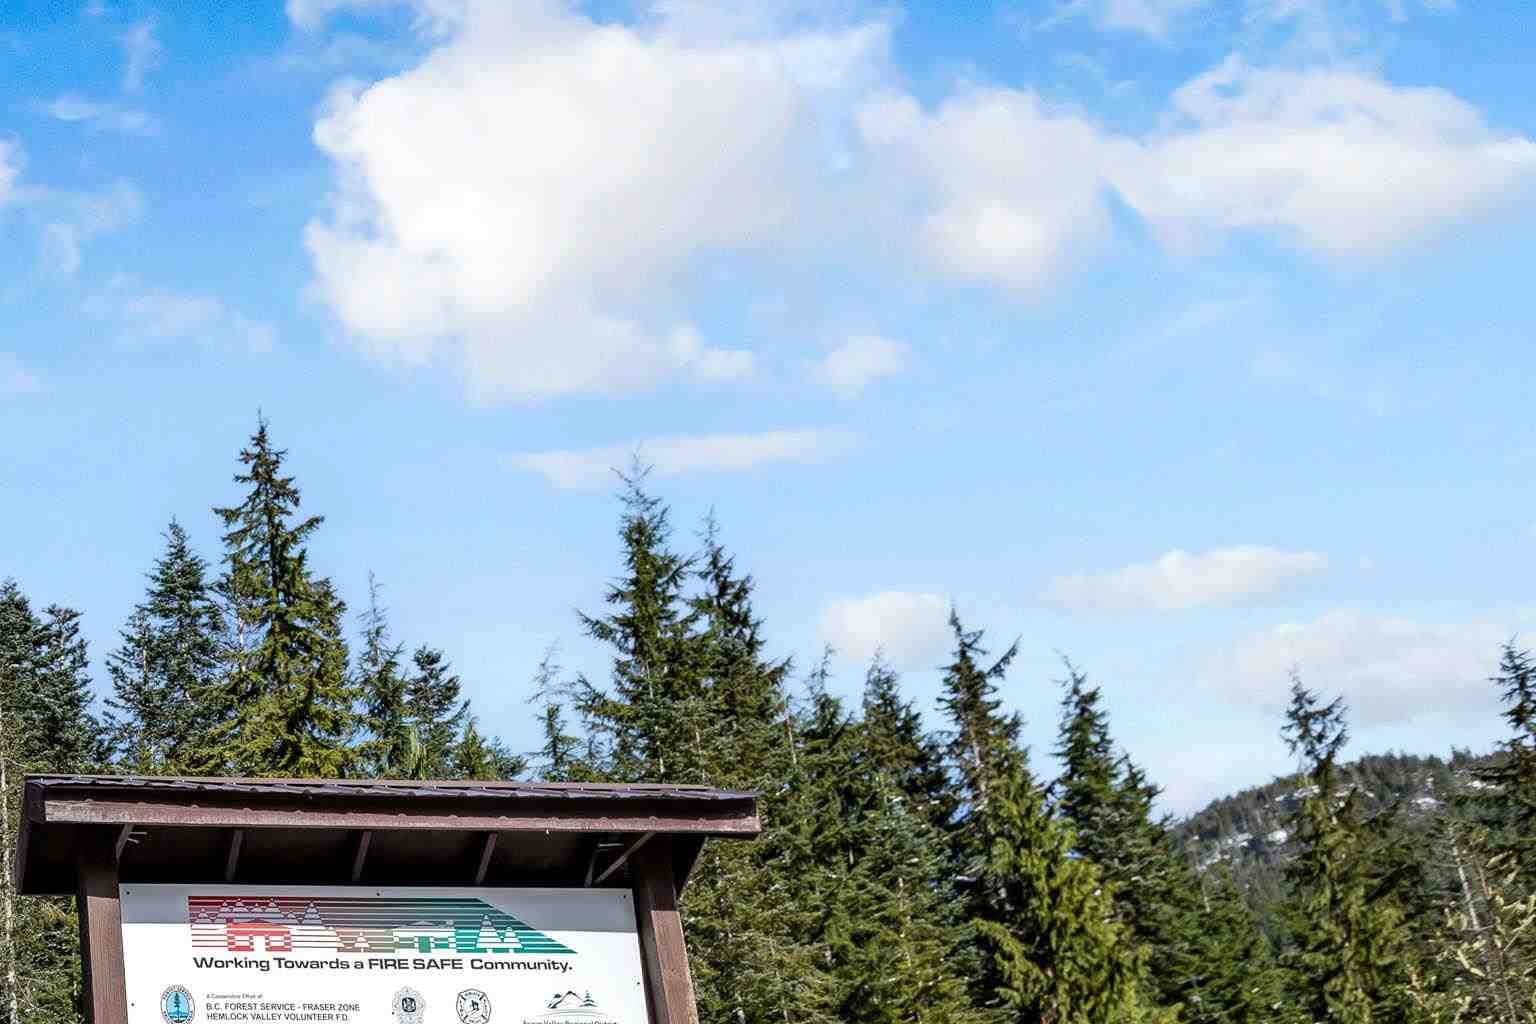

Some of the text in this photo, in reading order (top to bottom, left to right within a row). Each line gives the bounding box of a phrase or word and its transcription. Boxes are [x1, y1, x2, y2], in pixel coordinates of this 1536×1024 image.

[193, 957, 573, 973] Working Towards a FIRE SAFE Community.
[206, 1003, 222, 1011] B.C.
[225, 1003, 258, 1011] FOREST
[260, 1003, 296, 1011] SERVICE
[303, 1003, 336, 1011] FRASER
[338, 1003, 360, 1012] ZONE
[207, 1012, 248, 1021] HEMLOCK
[250, 1013, 282, 1021] VALLEY
[284, 1013, 333, 1021] VOLUNTEER
